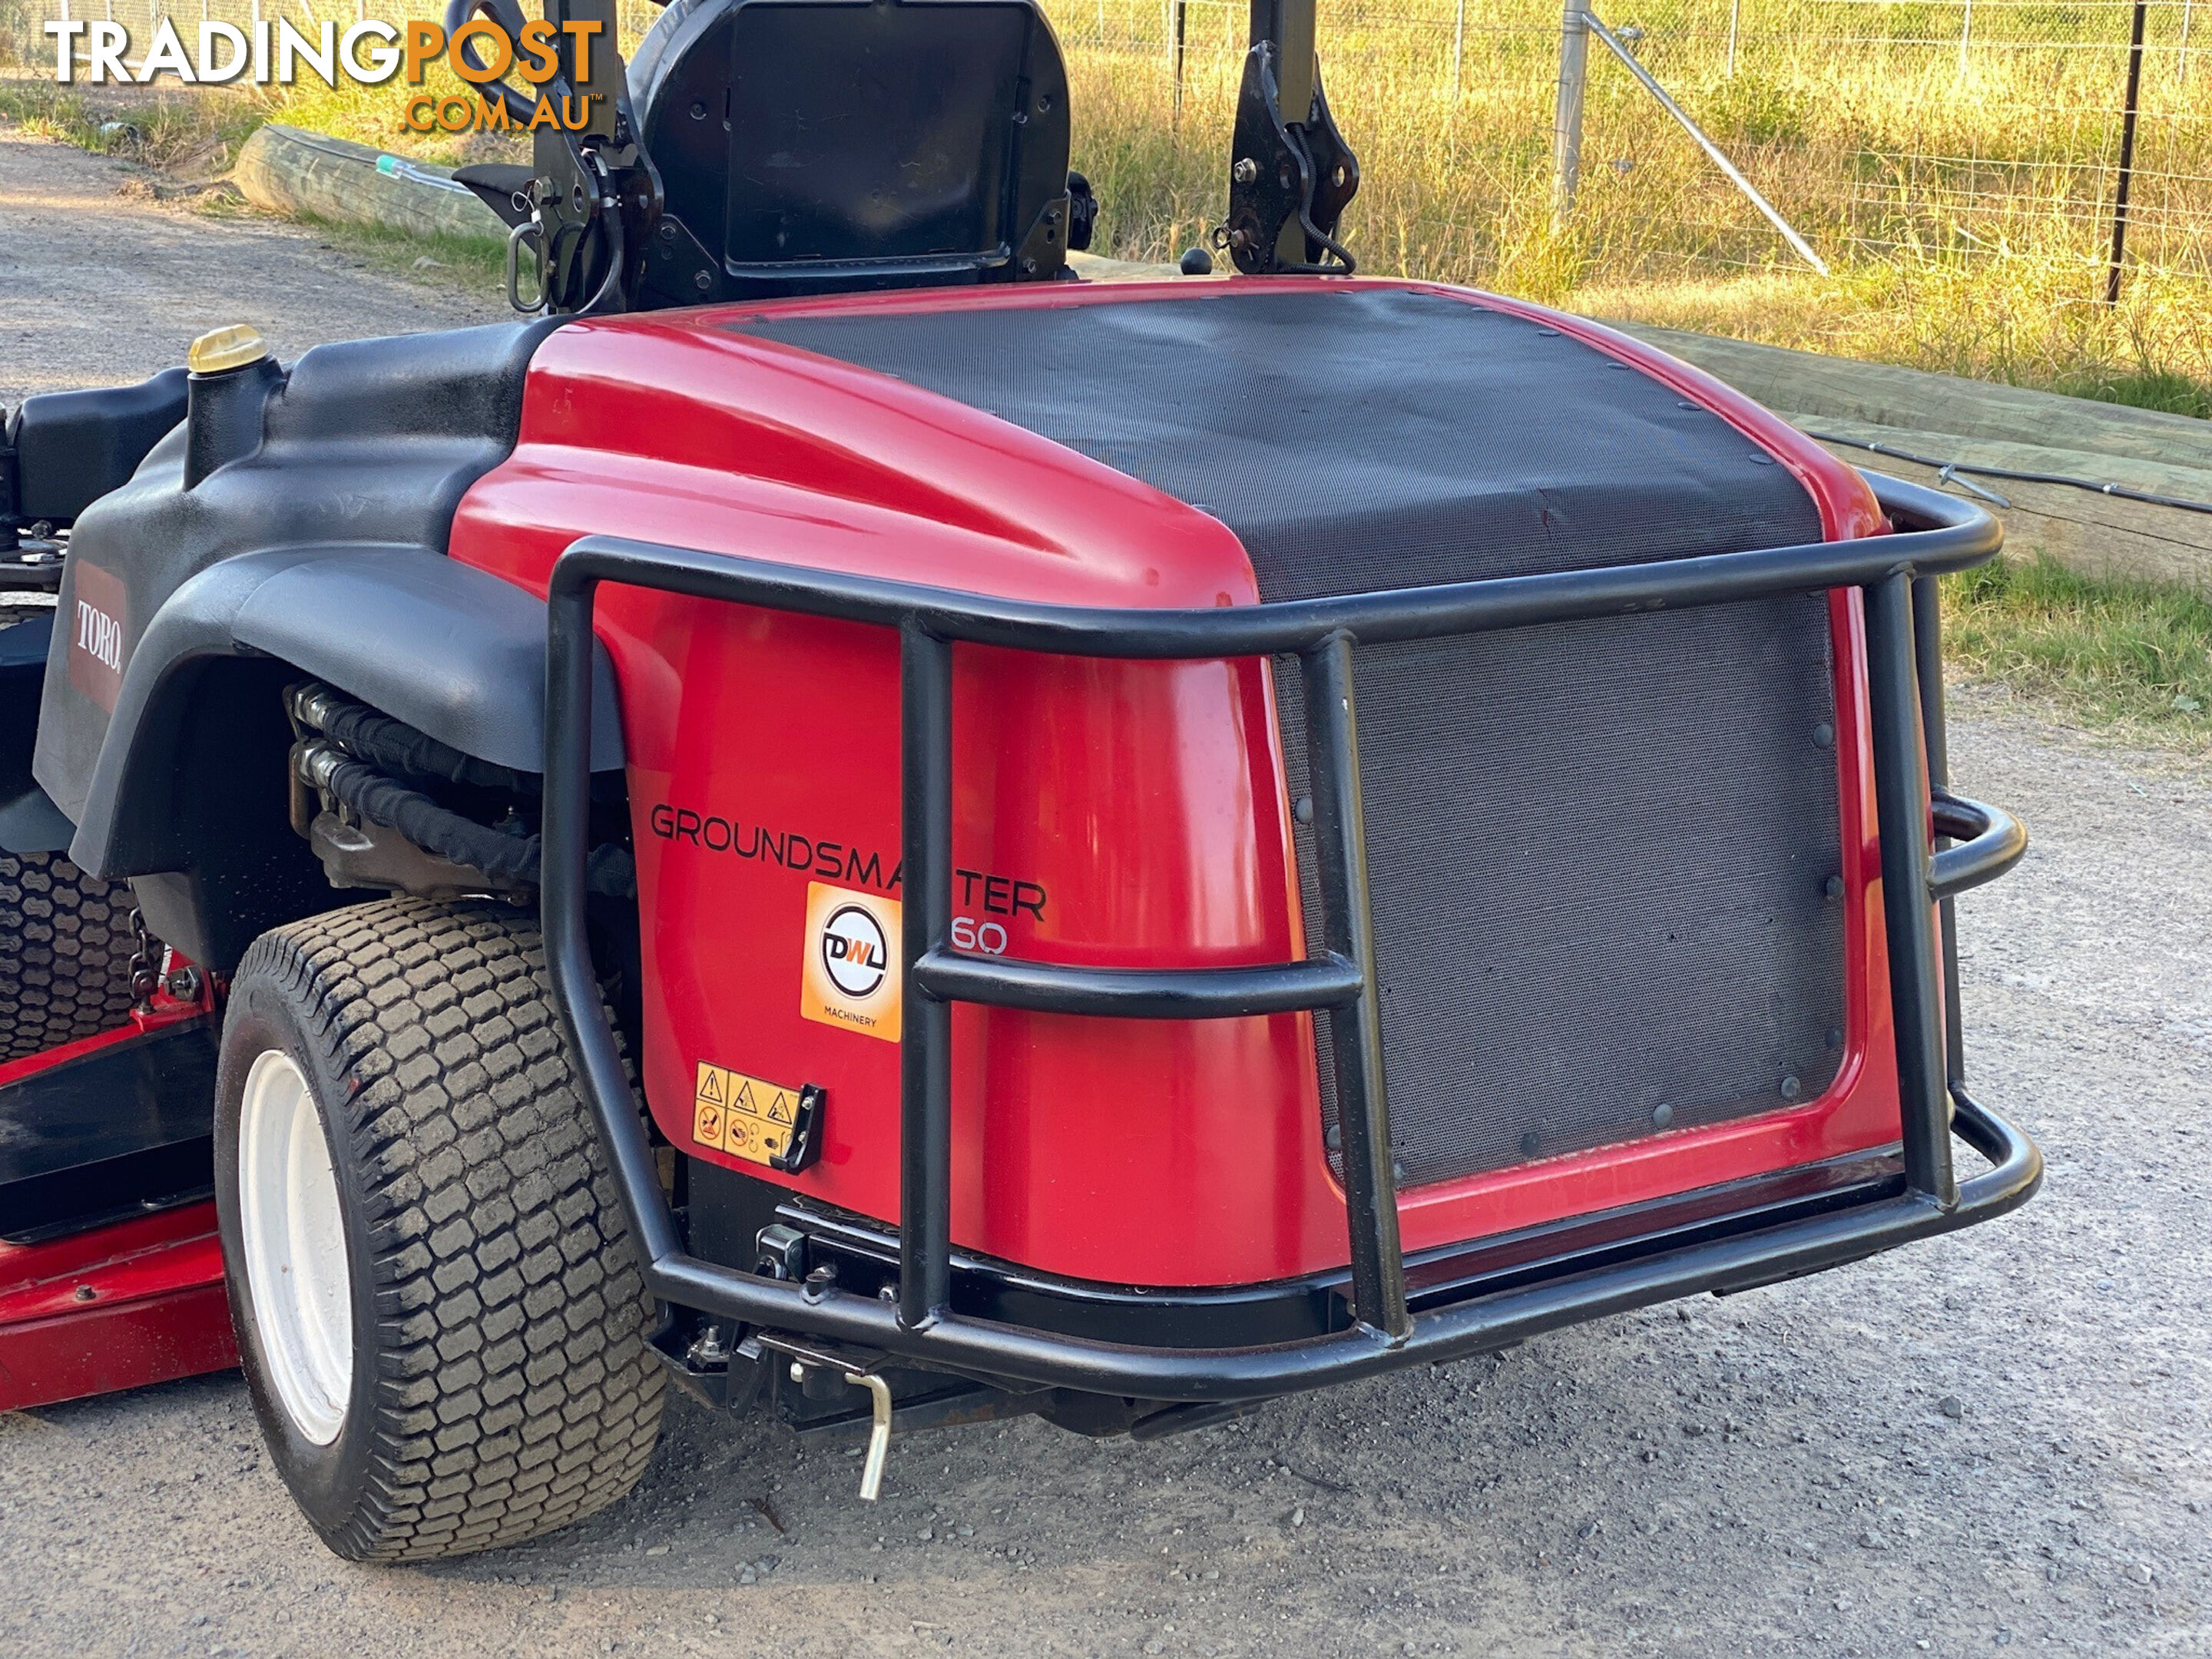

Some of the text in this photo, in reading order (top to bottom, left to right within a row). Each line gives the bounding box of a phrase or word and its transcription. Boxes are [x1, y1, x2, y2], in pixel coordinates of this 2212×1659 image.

[651, 803, 1047, 922] GROUNDSMTER
[823, 932, 887, 971] DWL
[824, 1005, 877, 1028] MACHINERY
